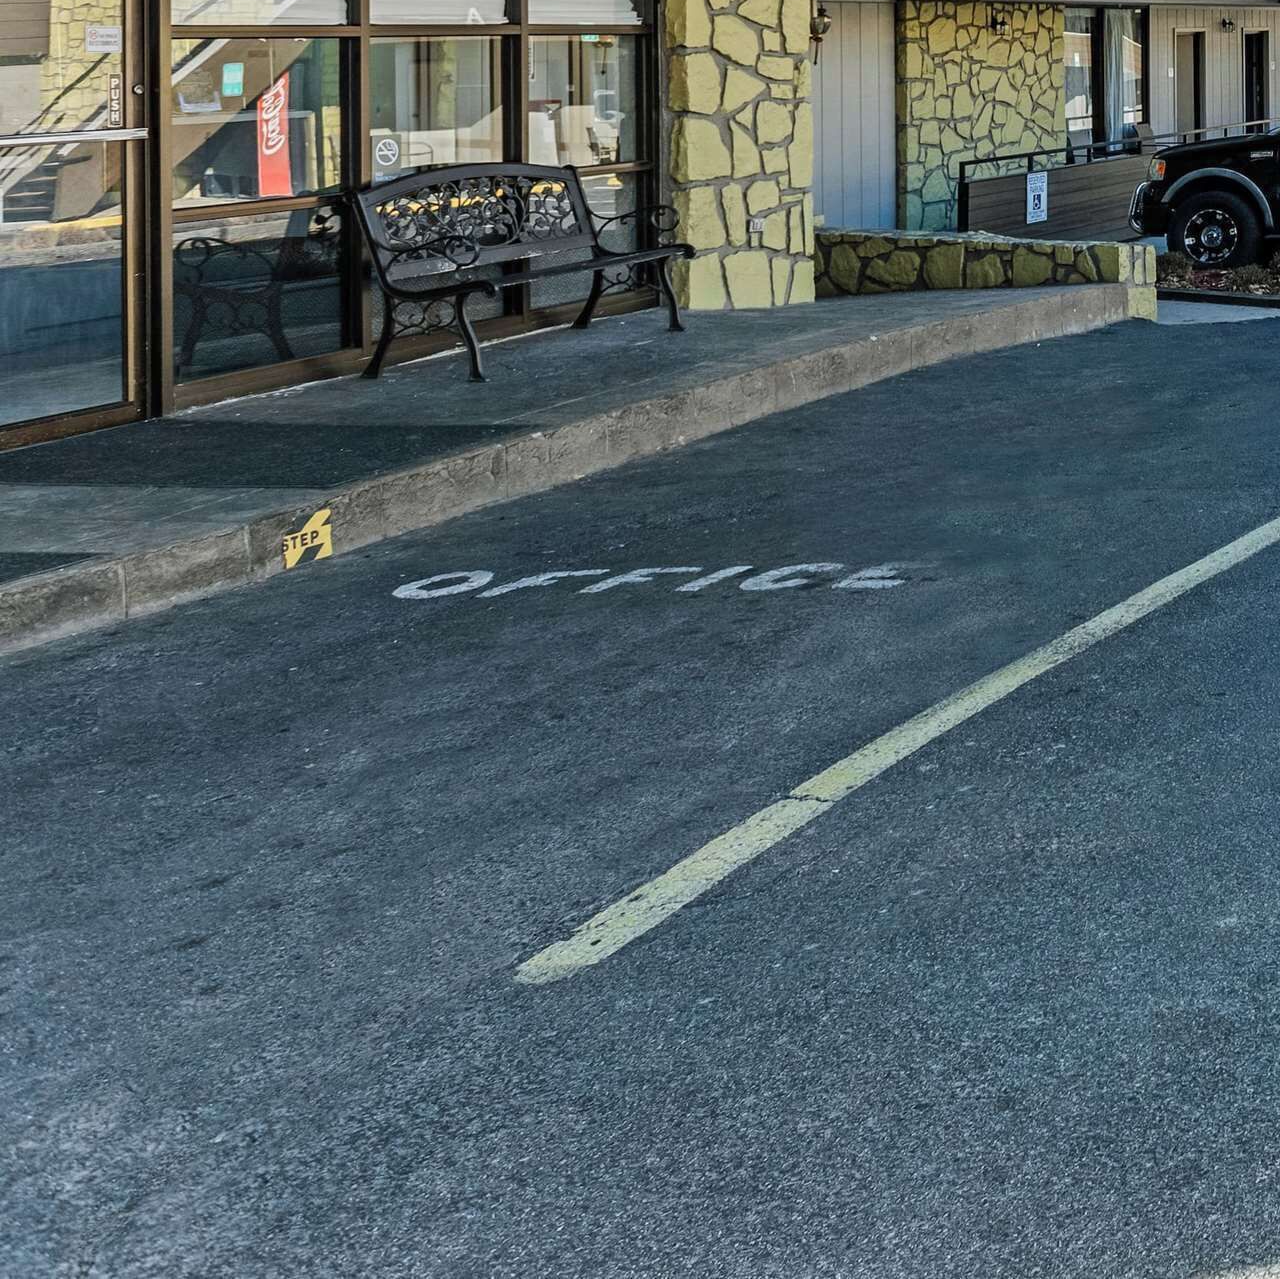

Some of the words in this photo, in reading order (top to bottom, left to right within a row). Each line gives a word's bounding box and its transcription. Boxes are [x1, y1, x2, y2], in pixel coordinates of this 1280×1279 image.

[110, 78, 120, 122] PUSH
[281, 530, 320, 555] STEP
[391, 562, 918, 600] OFFICE
